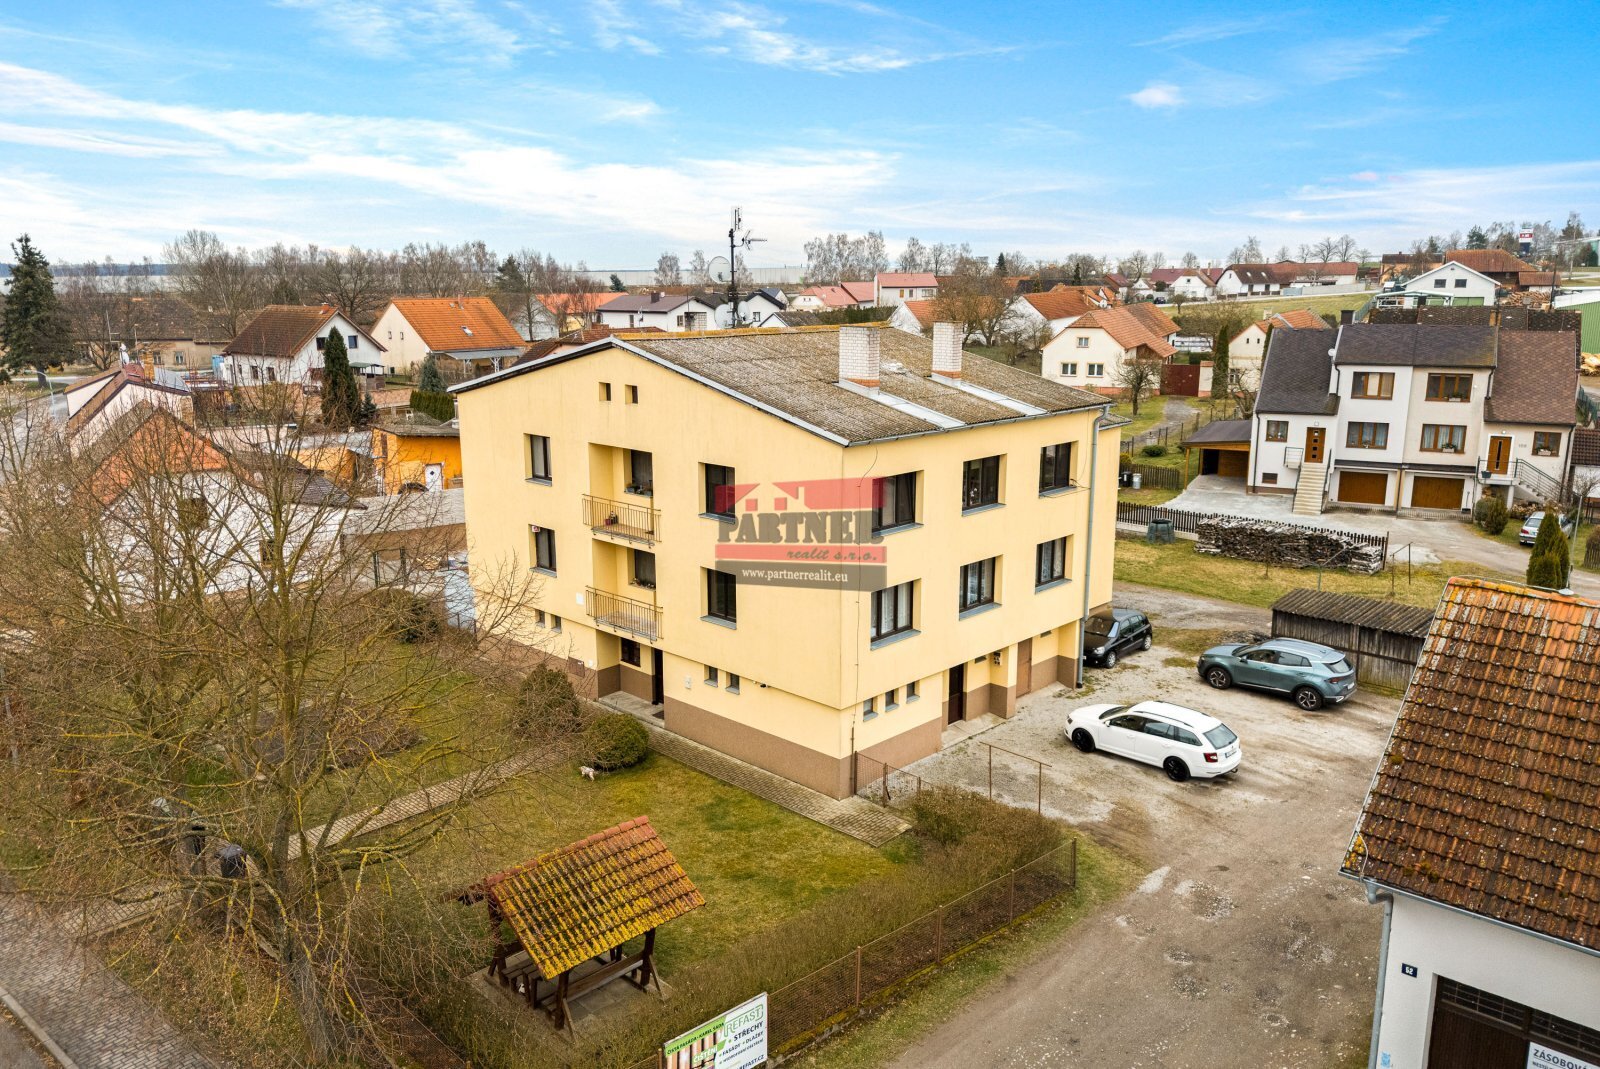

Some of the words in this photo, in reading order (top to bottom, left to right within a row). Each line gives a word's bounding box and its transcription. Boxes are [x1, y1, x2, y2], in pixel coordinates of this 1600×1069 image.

[724, 1006, 763, 1037] REFAST
[734, 1021, 763, 1041] STŘECHY
[1533, 1048, 1588, 1069] ZÁSOBOV
